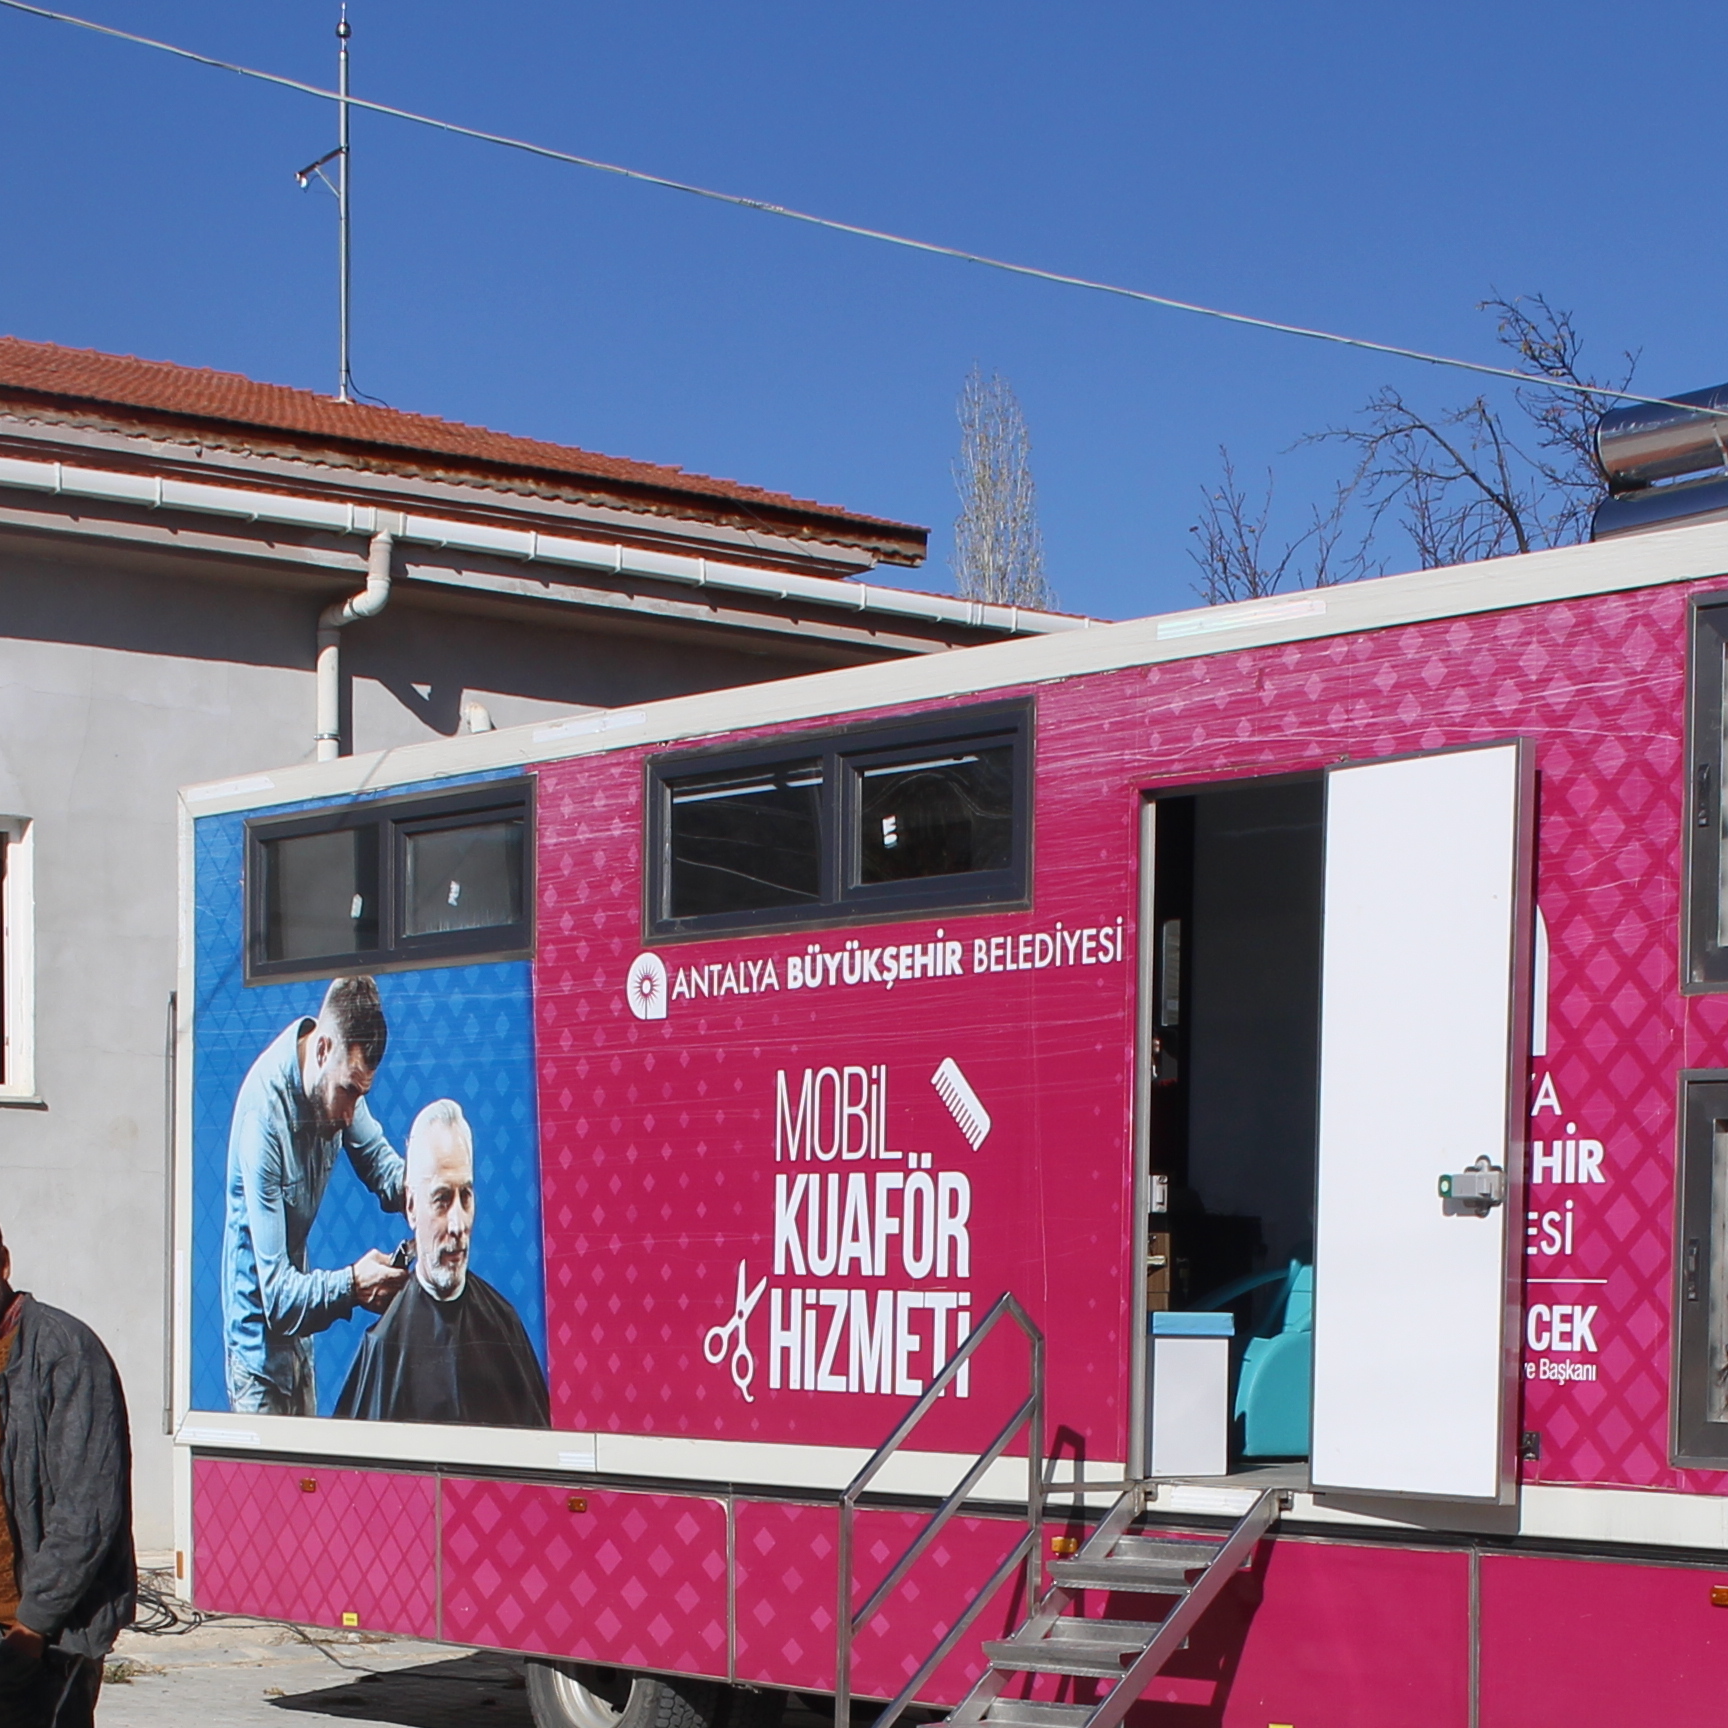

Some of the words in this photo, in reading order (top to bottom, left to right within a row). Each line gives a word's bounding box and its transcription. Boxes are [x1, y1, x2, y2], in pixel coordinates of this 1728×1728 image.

[671, 957, 780, 1000] ANTALYA
[787, 928, 964, 990] BÜYÜKŞEHİR
[973, 916, 1123, 974] BELEDİYESİ
[774, 1152, 971, 1279] KUAFÖR
[1539, 1358, 1597, 1386] Başkanı
